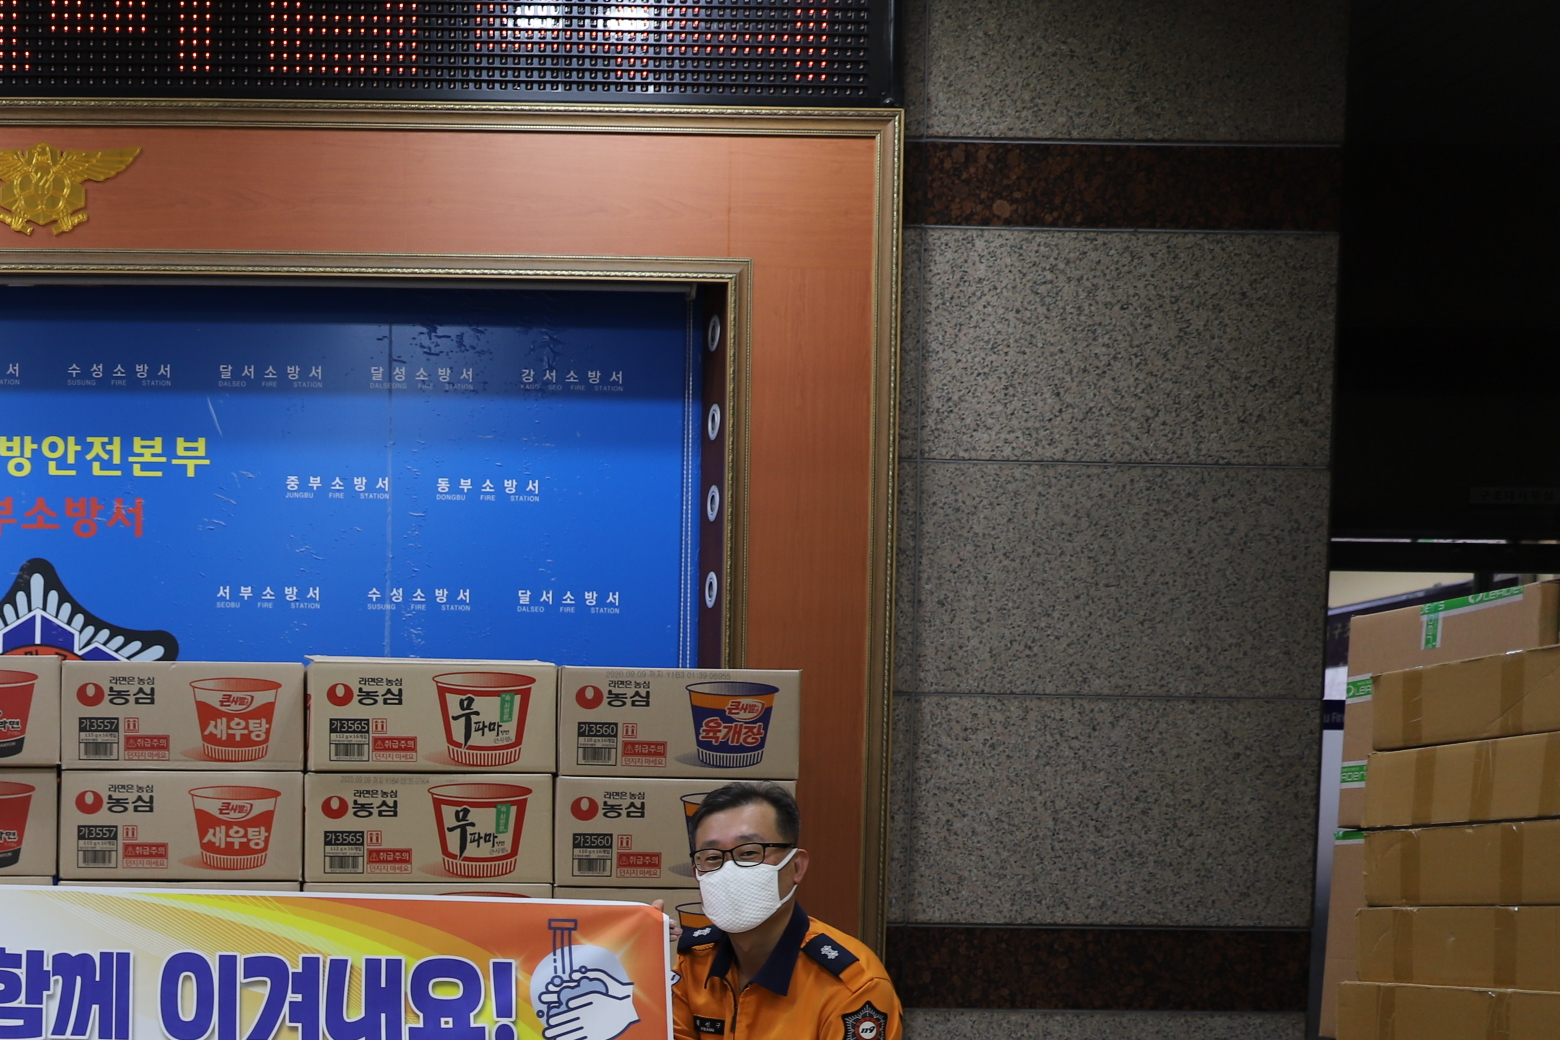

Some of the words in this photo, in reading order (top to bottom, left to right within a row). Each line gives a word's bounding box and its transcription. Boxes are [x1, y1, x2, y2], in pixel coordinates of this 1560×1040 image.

[67, 363, 171, 379] 수성소방서
[219, 364, 322, 380] 달서소방서
[370, 366, 473, 383] 달성소방서
[521, 368, 623, 385] 강서소방서
[67, 378, 97, 386] SUSUNG
[141, 379, 172, 387] STATION
[285, 475, 389, 492] 중부소방서
[436, 477, 539, 495] 동부소방서
[284, 491, 314, 499] JUNGBU
[359, 492, 390, 500] STATION
[435, 493, 466, 501] DONGBU
[479, 494, 496, 502] FIRE
[508, 492, 540, 501] STATION
[216, 585, 320, 602] 서부소방서
[367, 587, 470, 604] 수성소방서
[518, 589, 619, 607] 달서소방서
[216, 601, 241, 609] SEOBU
[257, 601, 273, 609] FIRE
[290, 602, 321, 610] STATION
[516, 605, 545, 613] DALSEO
[559, 606, 576, 614] FIRE
[588, 604, 620, 613] STATION
[108, 686, 155, 705] 농심
[357, 687, 403, 706] 농심
[606, 689, 651, 707] 농심
[81, 719, 117, 730] 가3557
[204, 718, 269, 741] 새우탕
[331, 720, 368, 731] 가3565
[579, 724, 616, 735] 가3560
[700, 717, 764, 746] 육개장
[106, 795, 154, 813] 농심
[352, 799, 398, 818] 농심
[602, 801, 645, 819] 농심
[79, 827, 116, 838] 가3557
[202, 826, 268, 849] 새우탕
[326, 833, 362, 844] 가3565
[574, 836, 611, 846] 가3560
[861, 1026, 875, 1034] 119
